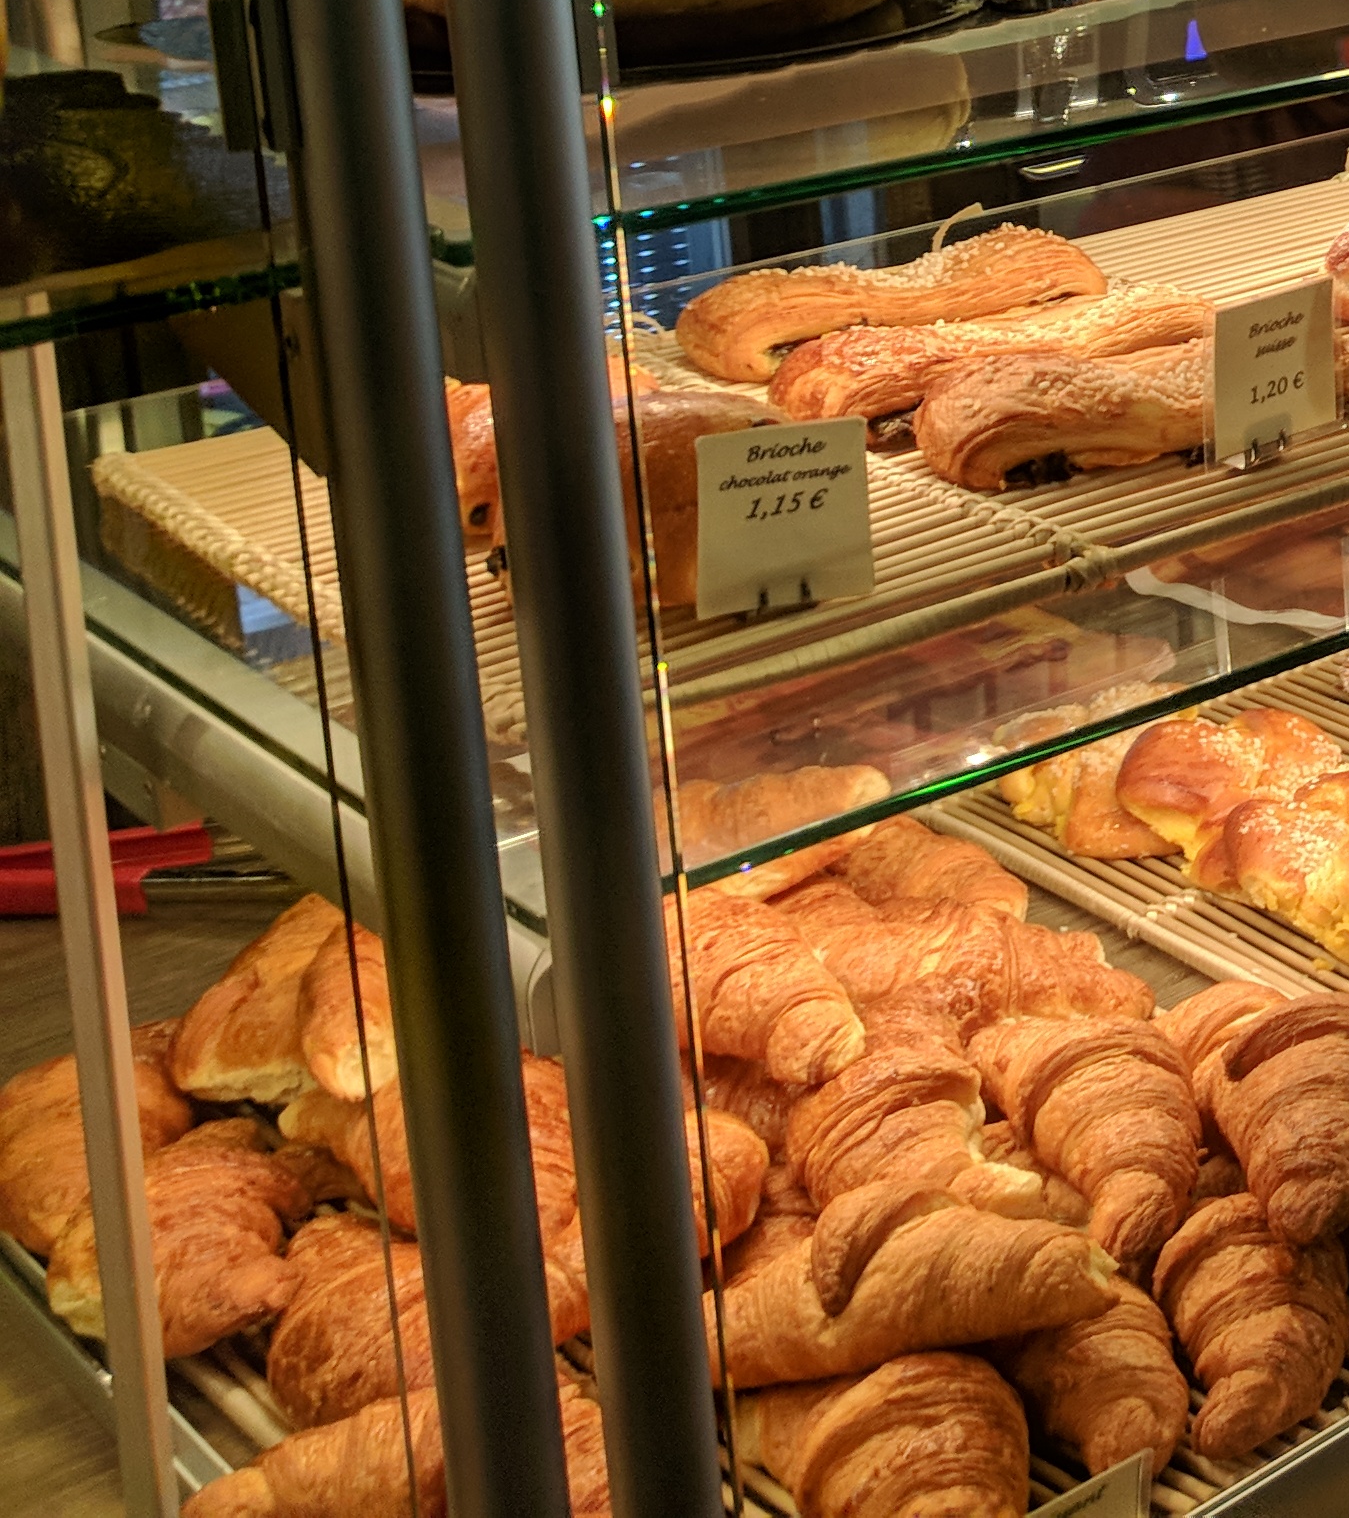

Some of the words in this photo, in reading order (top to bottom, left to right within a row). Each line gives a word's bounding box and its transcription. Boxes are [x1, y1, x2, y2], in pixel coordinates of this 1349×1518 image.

[1248, 311, 1305, 339] Brioche
[1250, 376, 1289, 404] 1,20
[1293, 370, 1305, 390] €
[747, 437, 828, 463] Brioche
[719, 470, 791, 492] chocolat
[792, 464, 853, 481] orange
[745, 491, 805, 520] 1,15
[810, 488, 829, 510] €
